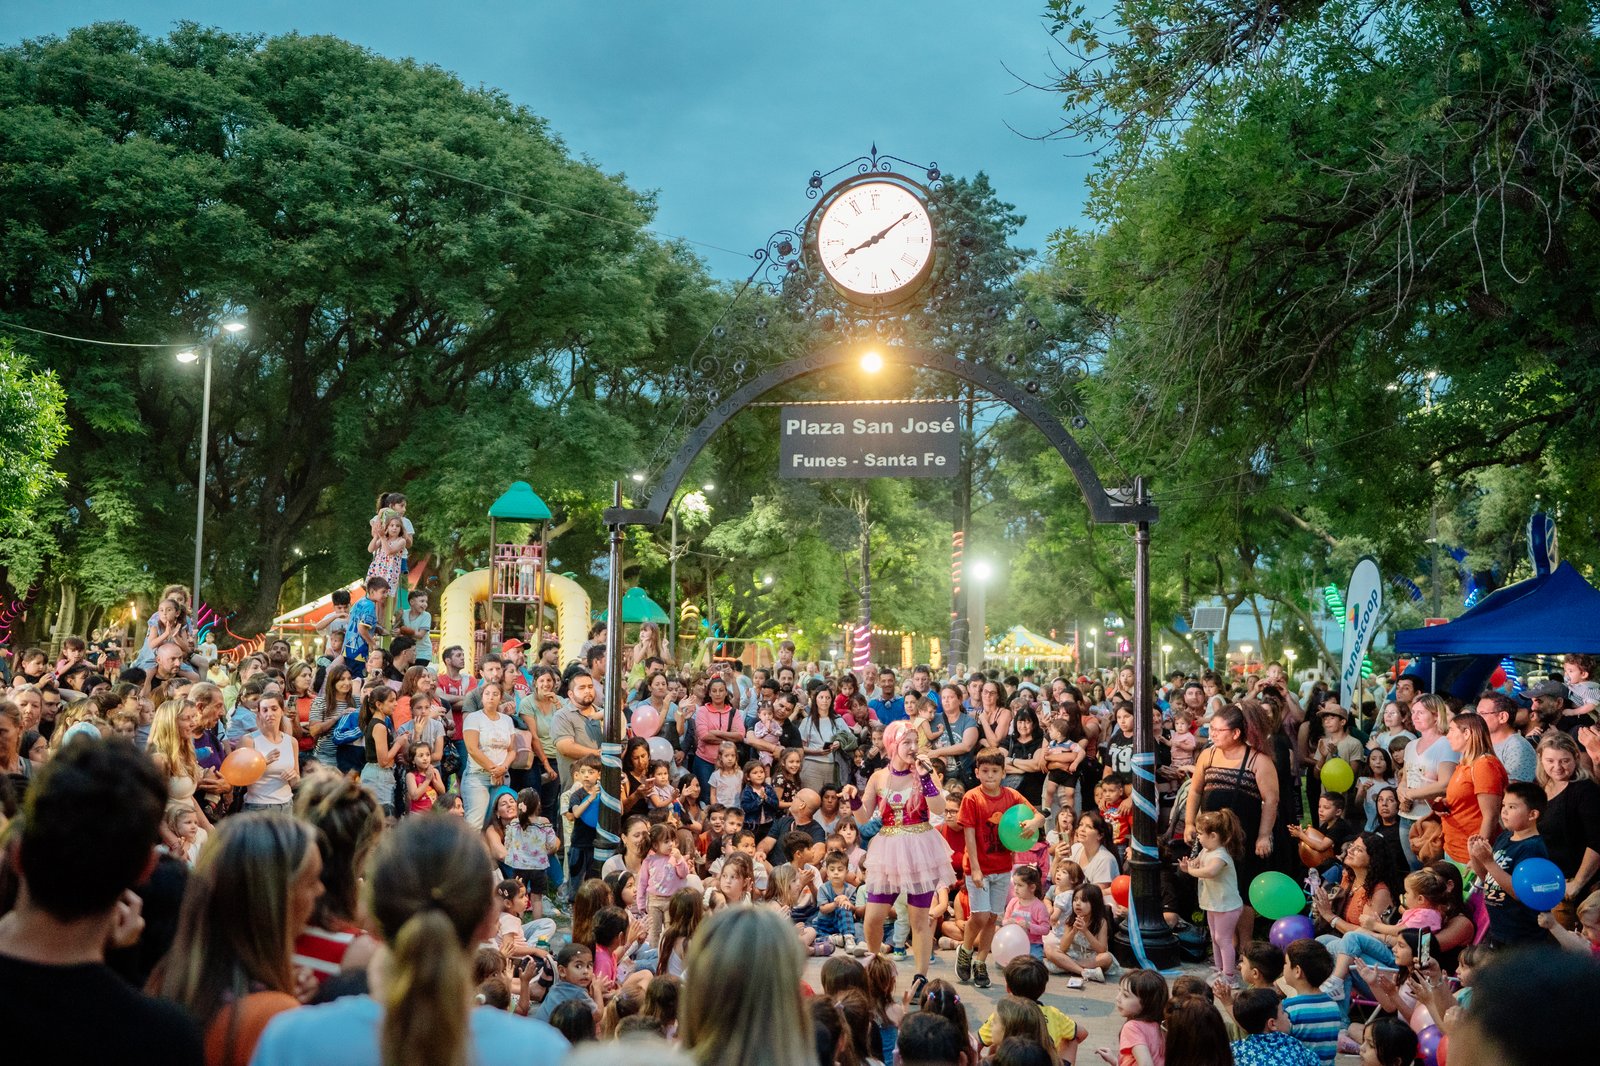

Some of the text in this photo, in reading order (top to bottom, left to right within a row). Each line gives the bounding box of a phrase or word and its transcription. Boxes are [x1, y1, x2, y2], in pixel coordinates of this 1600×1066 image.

[786, 417, 955, 436] Plaza San José
[792, 454, 848, 468] Funes
[864, 453, 918, 467] Santa
[923, 452, 947, 466] Fe
[1108, 747, 1133, 773] 79
